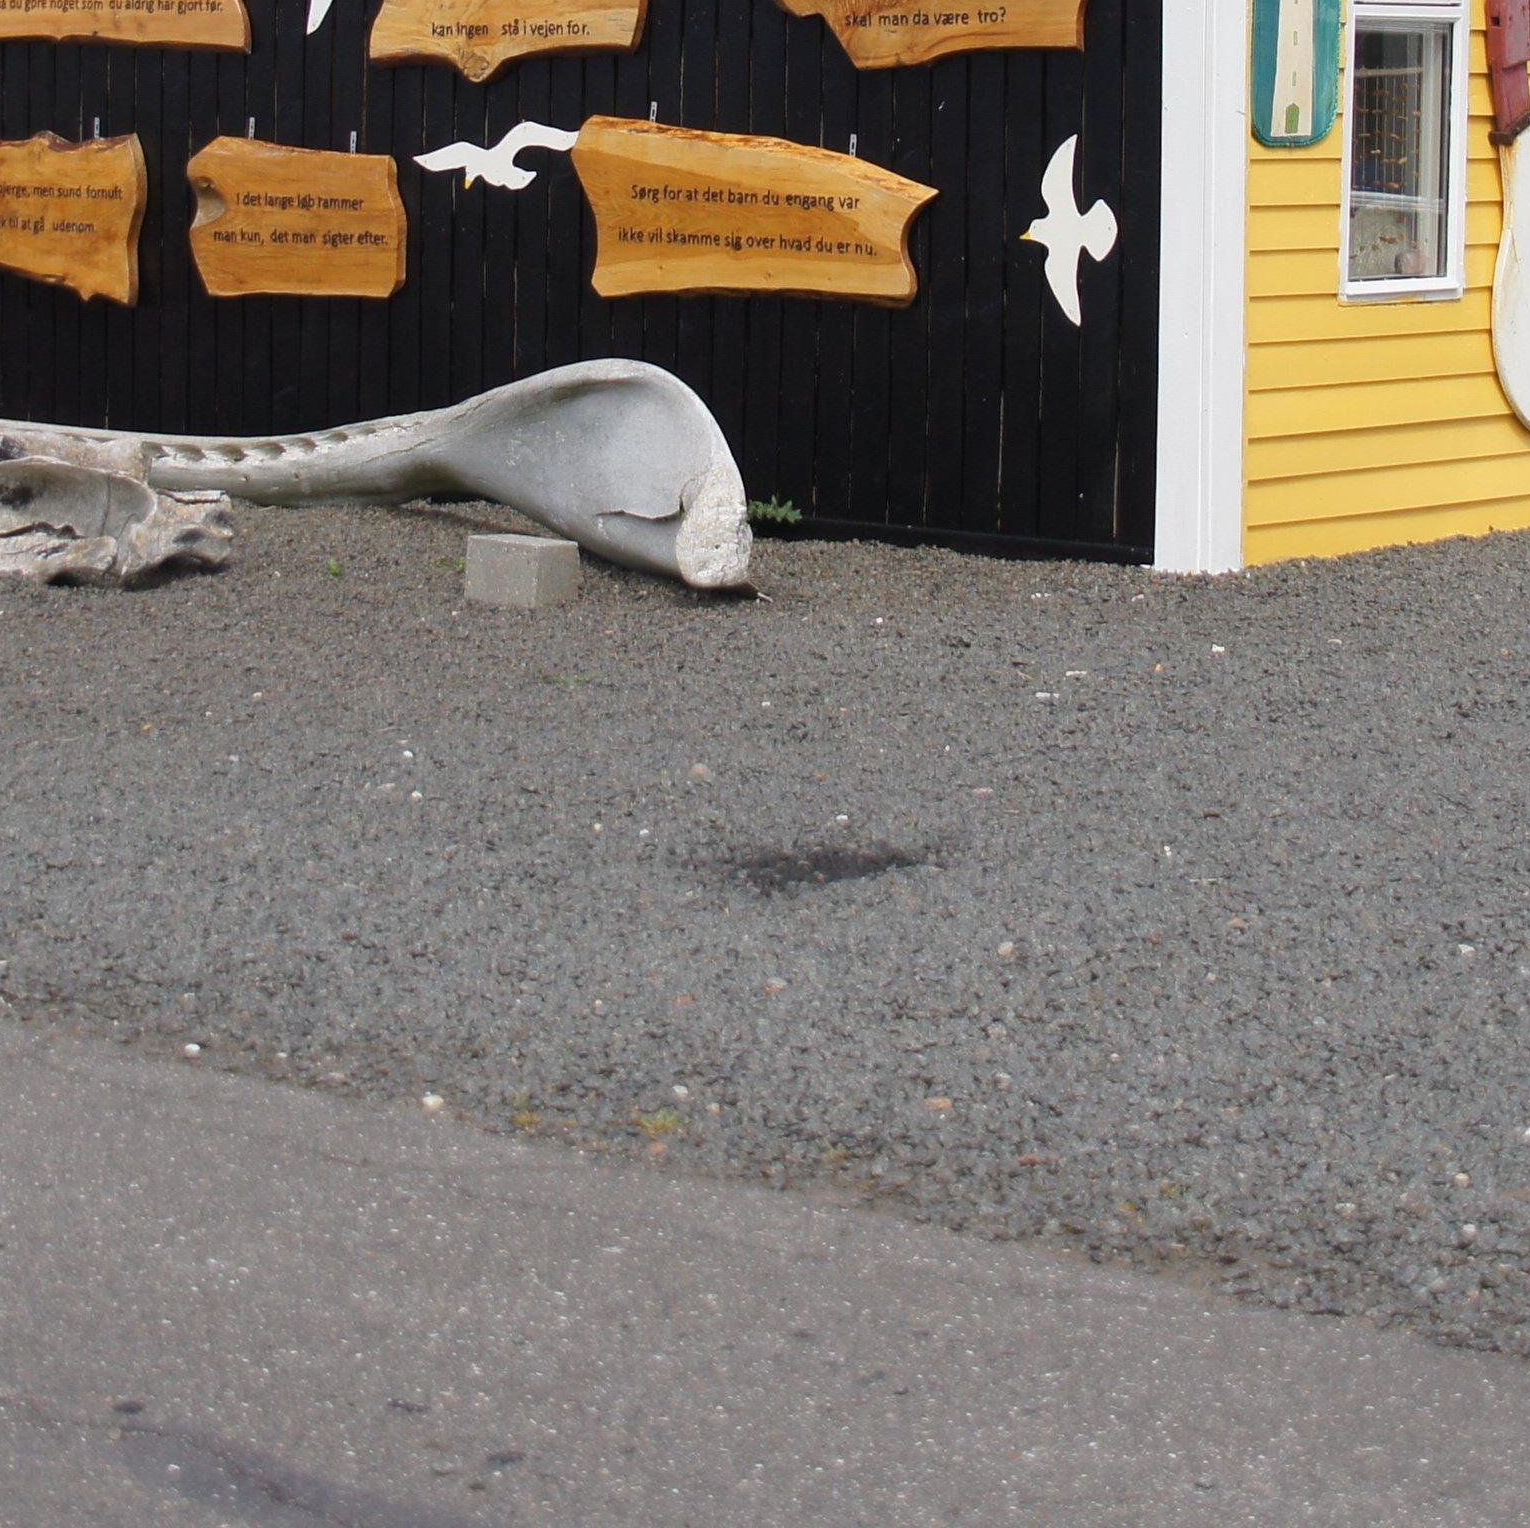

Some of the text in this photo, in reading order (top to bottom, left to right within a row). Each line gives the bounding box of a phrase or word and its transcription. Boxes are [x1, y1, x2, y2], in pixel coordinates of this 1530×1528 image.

[81, 0, 103, 10] som
[845, 7, 1007, 28] skal man da være tro?
[431, 22, 453, 37] kan
[456, 22, 489, 39] ingen
[501, 18, 520, 36] stå
[530, 20, 564, 39] vejen
[33, 185, 55, 196] men
[58, 185, 82, 198] sund
[86, 184, 123, 201] fornuft
[242, 191, 262, 207] det
[264, 192, 295, 211] lange
[297, 193, 315, 211] løb
[317, 196, 365, 211] rammer
[630, 183, 861, 212] Sørg for at det barn du engang var
[8, 216, 19, 228] til
[21, 217, 31, 230] at
[33, 216, 46, 234] gå
[213, 229, 389, 247] man kun, det man sigter efter.
[618, 227, 878, 257] ikke vil skamme sig over hvad du er nu.
